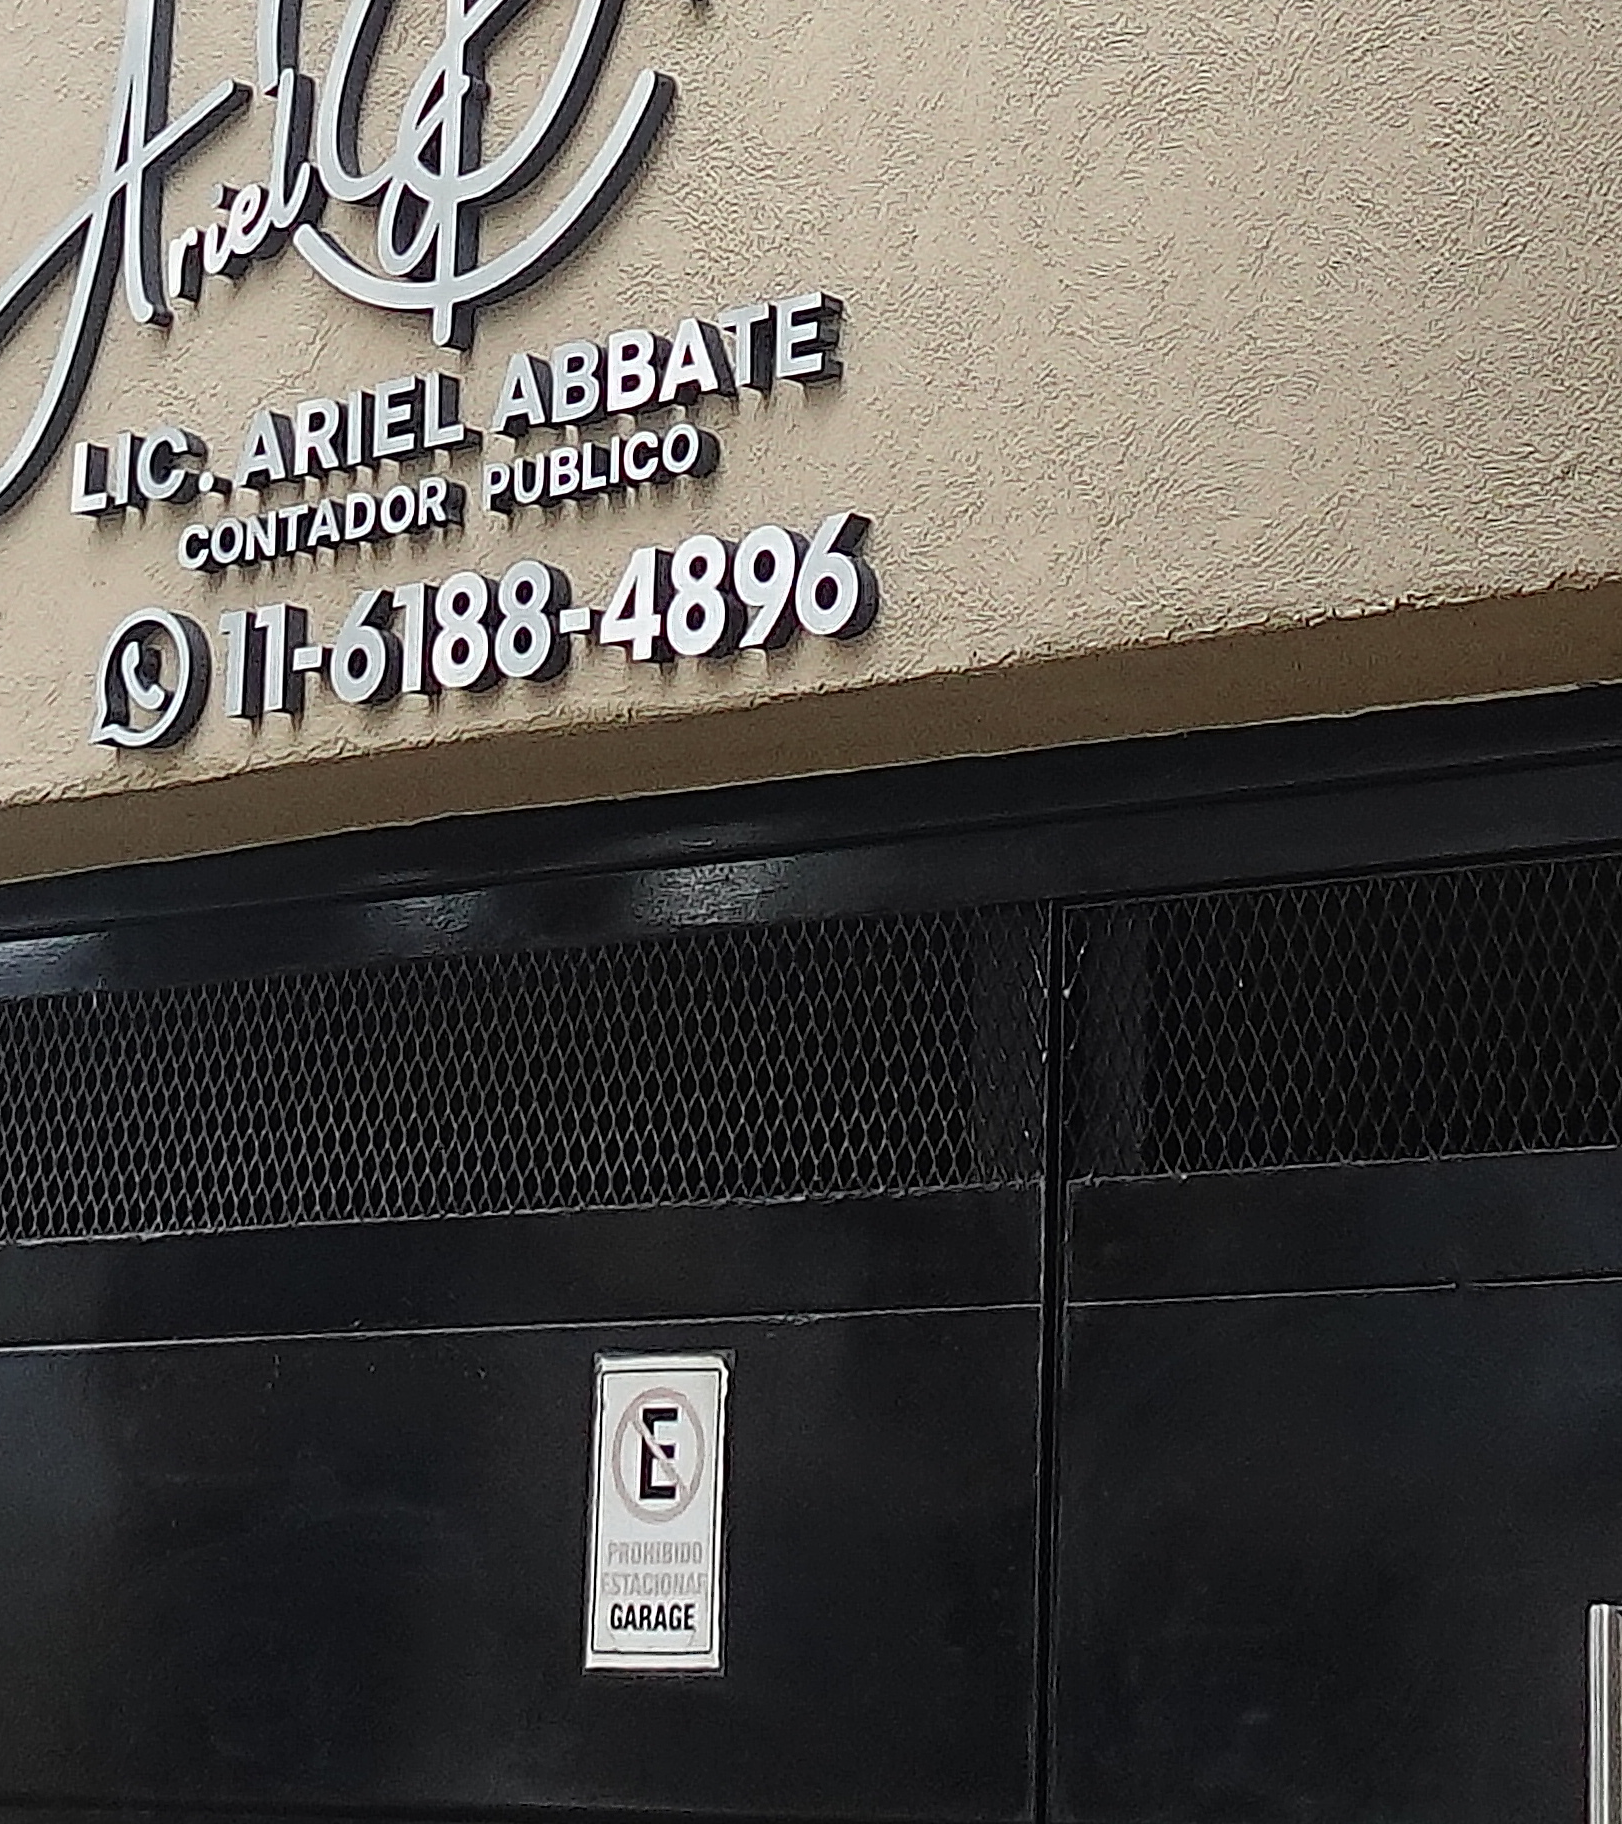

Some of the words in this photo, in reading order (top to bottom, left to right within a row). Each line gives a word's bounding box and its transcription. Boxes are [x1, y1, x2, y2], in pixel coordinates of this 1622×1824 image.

[69, 425, 219, 518] LIC.
[231, 372, 474, 489] ARIEL
[490, 290, 839, 435] ABBATE
[176, 475, 459, 573] CONTADOR
[481, 422, 714, 513] PUBLICO
[217, 512, 869, 719] 11-6188-4896
[606, 1541, 703, 1567] PROHIBIDO
[609, 1602, 697, 1632] GARAGE
